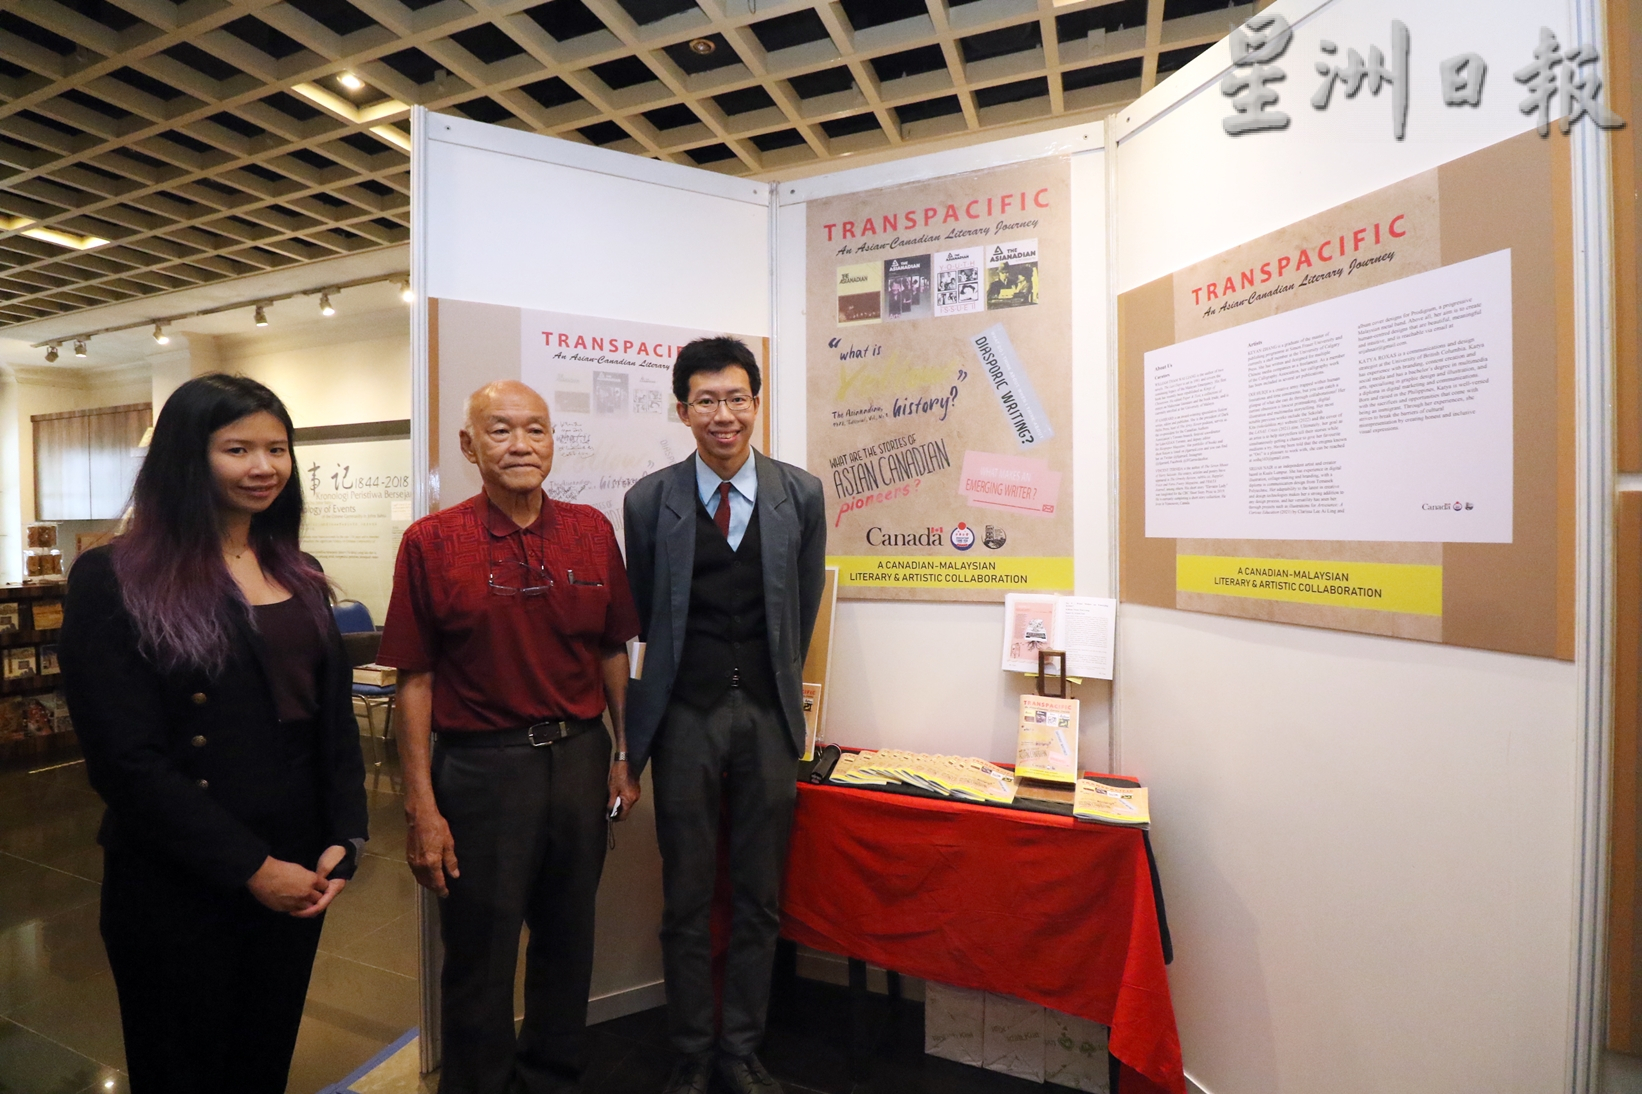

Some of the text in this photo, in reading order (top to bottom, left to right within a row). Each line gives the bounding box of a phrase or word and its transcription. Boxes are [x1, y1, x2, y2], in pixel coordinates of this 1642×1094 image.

[824, 188, 1050, 242] TRANSPACIFIC
[836, 218, 1038, 256] An Asian-Canadian Literary Journey
[990, 250, 1036, 262] ASIANADIAN
[1192, 214, 1407, 306] TRANSPACIFIC
[1202, 249, 1395, 318] An Asian-Canadian Literary Journey
[542, 331, 684, 358] TRANSPACIF
[872, 344, 882, 356] is
[569, 354, 636, 366] Asian-Canadian
[638, 360, 670, 370] Literary
[975, 336, 1034, 444] DIASPORIC WRITING?
[829, 433, 916, 468] WHAT ARE THE STORIES OF
[833, 438, 950, 499] ASIAN CANADIAN
[355, 476, 409, 488] 1844-2018
[966, 478, 1002, 496] EMERGING
[316, 490, 412, 502] Kronologi Peristiwa Berseja
[333, 505, 356, 513] Events
[1422, 502, 1452, 511] Canada
[866, 527, 944, 546] Canada
[886, 561, 996, 570] CANADIAN-MALAYSIAN
[1238, 567, 1348, 582] A CANADIAN-MALAYSIAN
[850, 573, 892, 581] LITERARY
[902, 574, 942, 582] ARTISTIC
[944, 574, 1028, 584] COLLABORATION
[1214, 577, 1382, 598] LITERARY & ARTISTIC COLLABORATION
